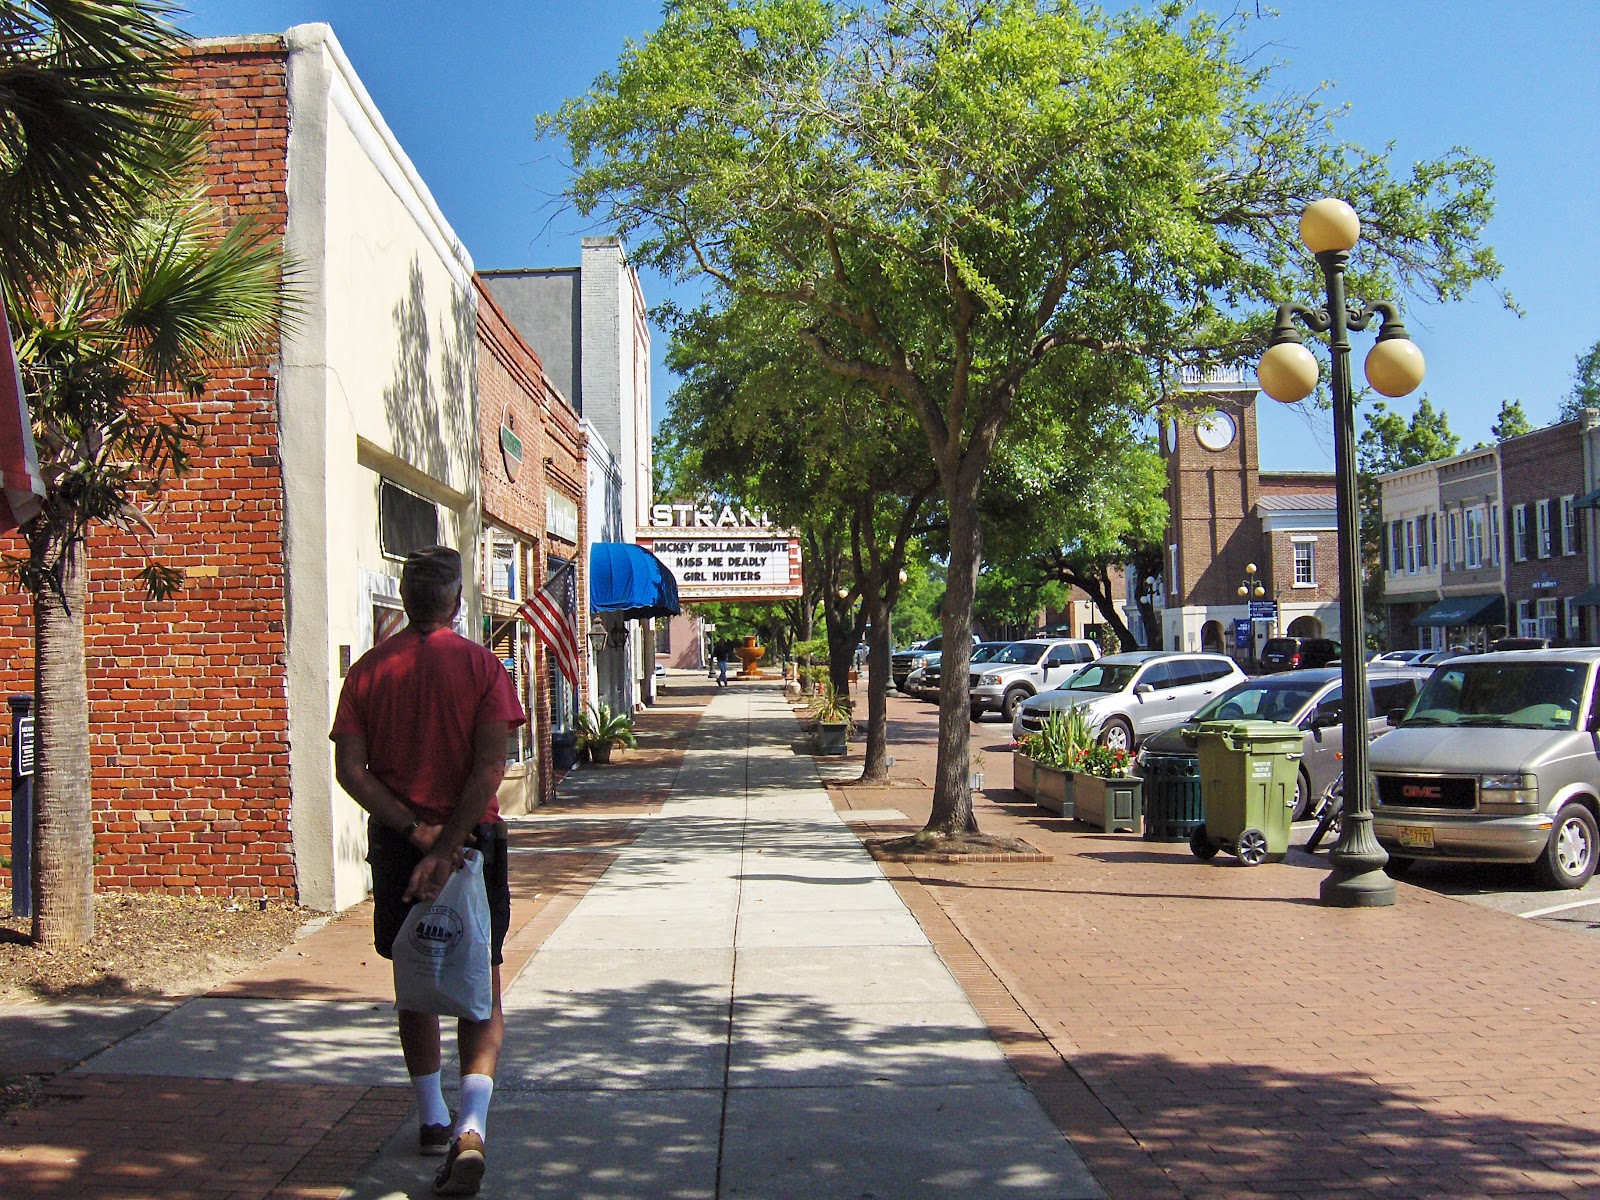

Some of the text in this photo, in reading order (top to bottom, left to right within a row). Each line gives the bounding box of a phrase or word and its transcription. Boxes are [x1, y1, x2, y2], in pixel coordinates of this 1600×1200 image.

[654, 542, 788, 553] MICKEY SPILLANE TRIBUTE
[676, 557, 767, 567] KISS ME DEADLY
[683, 571, 761, 582] GIRL HUNTERS
[1403, 785, 1441, 798] GMC
